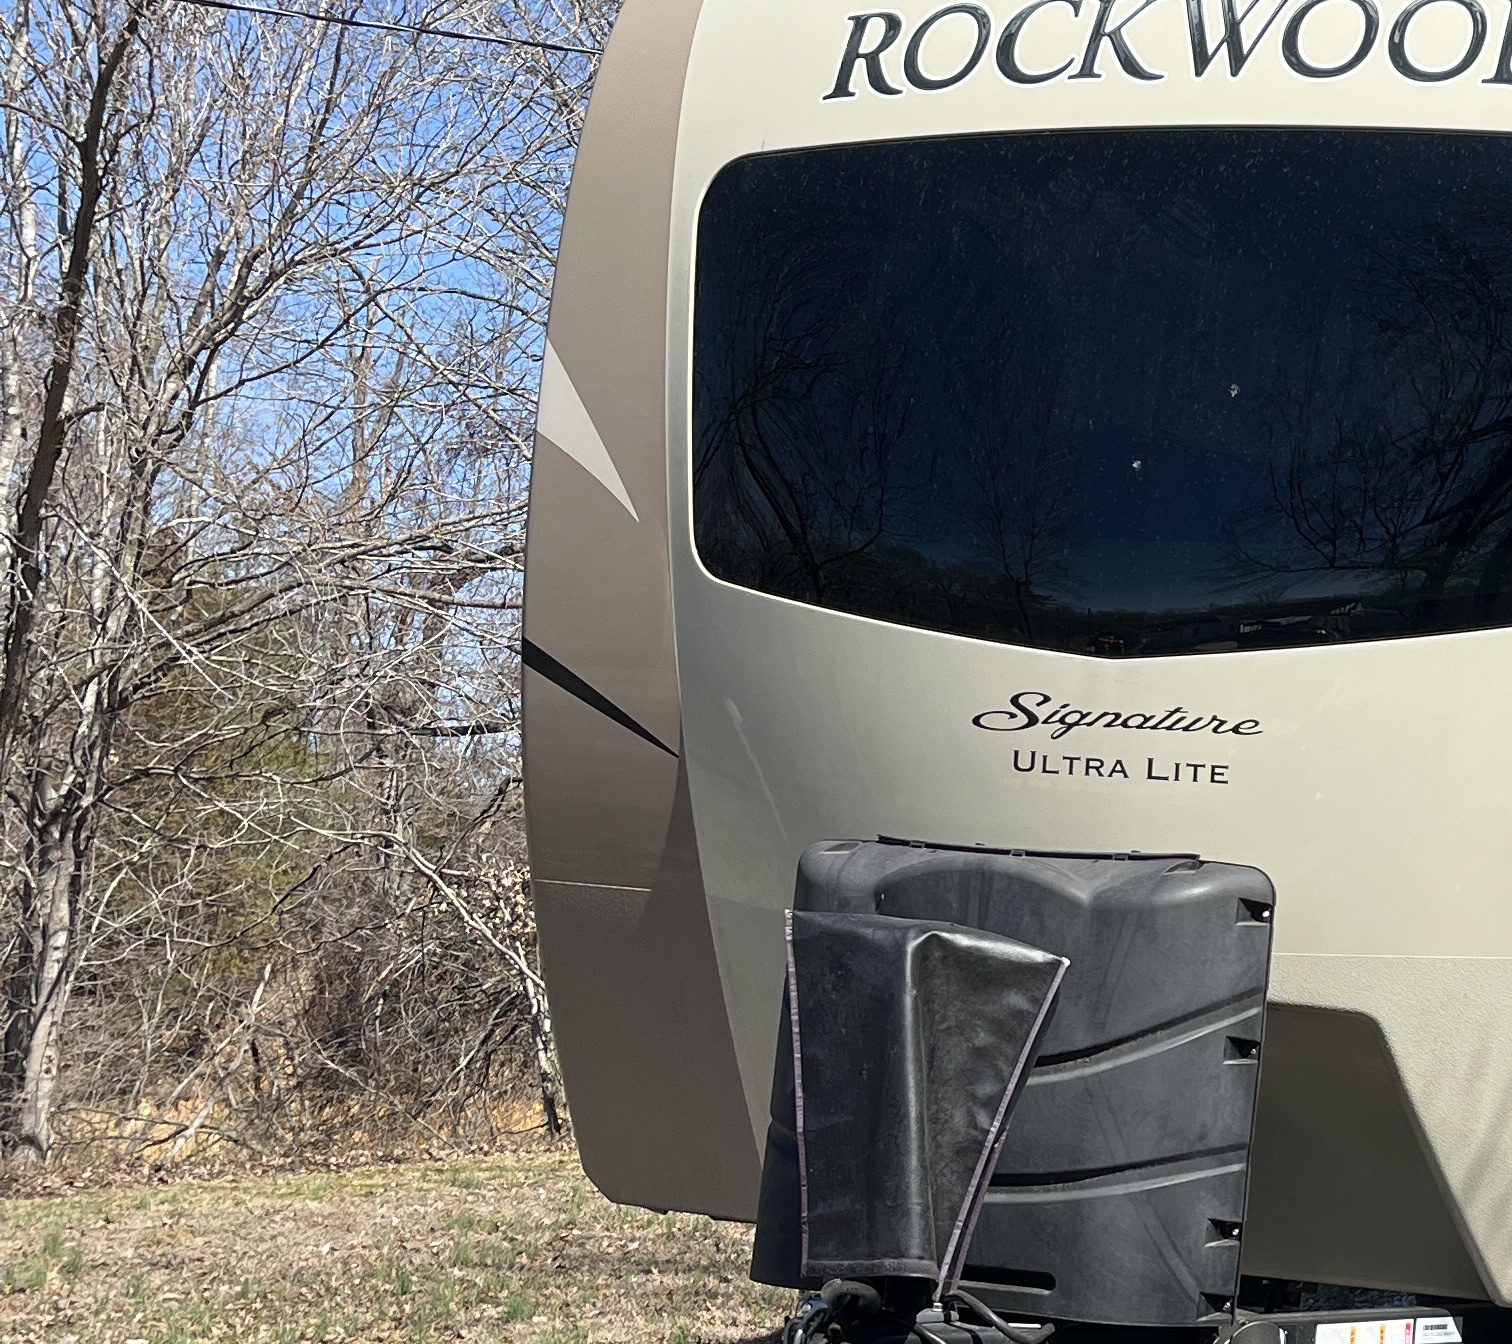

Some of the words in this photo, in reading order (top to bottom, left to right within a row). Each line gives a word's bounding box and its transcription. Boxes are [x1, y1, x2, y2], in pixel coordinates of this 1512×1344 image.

[972, 692, 1263, 740] Signature
[1013, 749, 1130, 779] ULTRA
[1145, 757, 1229, 785] LITE
